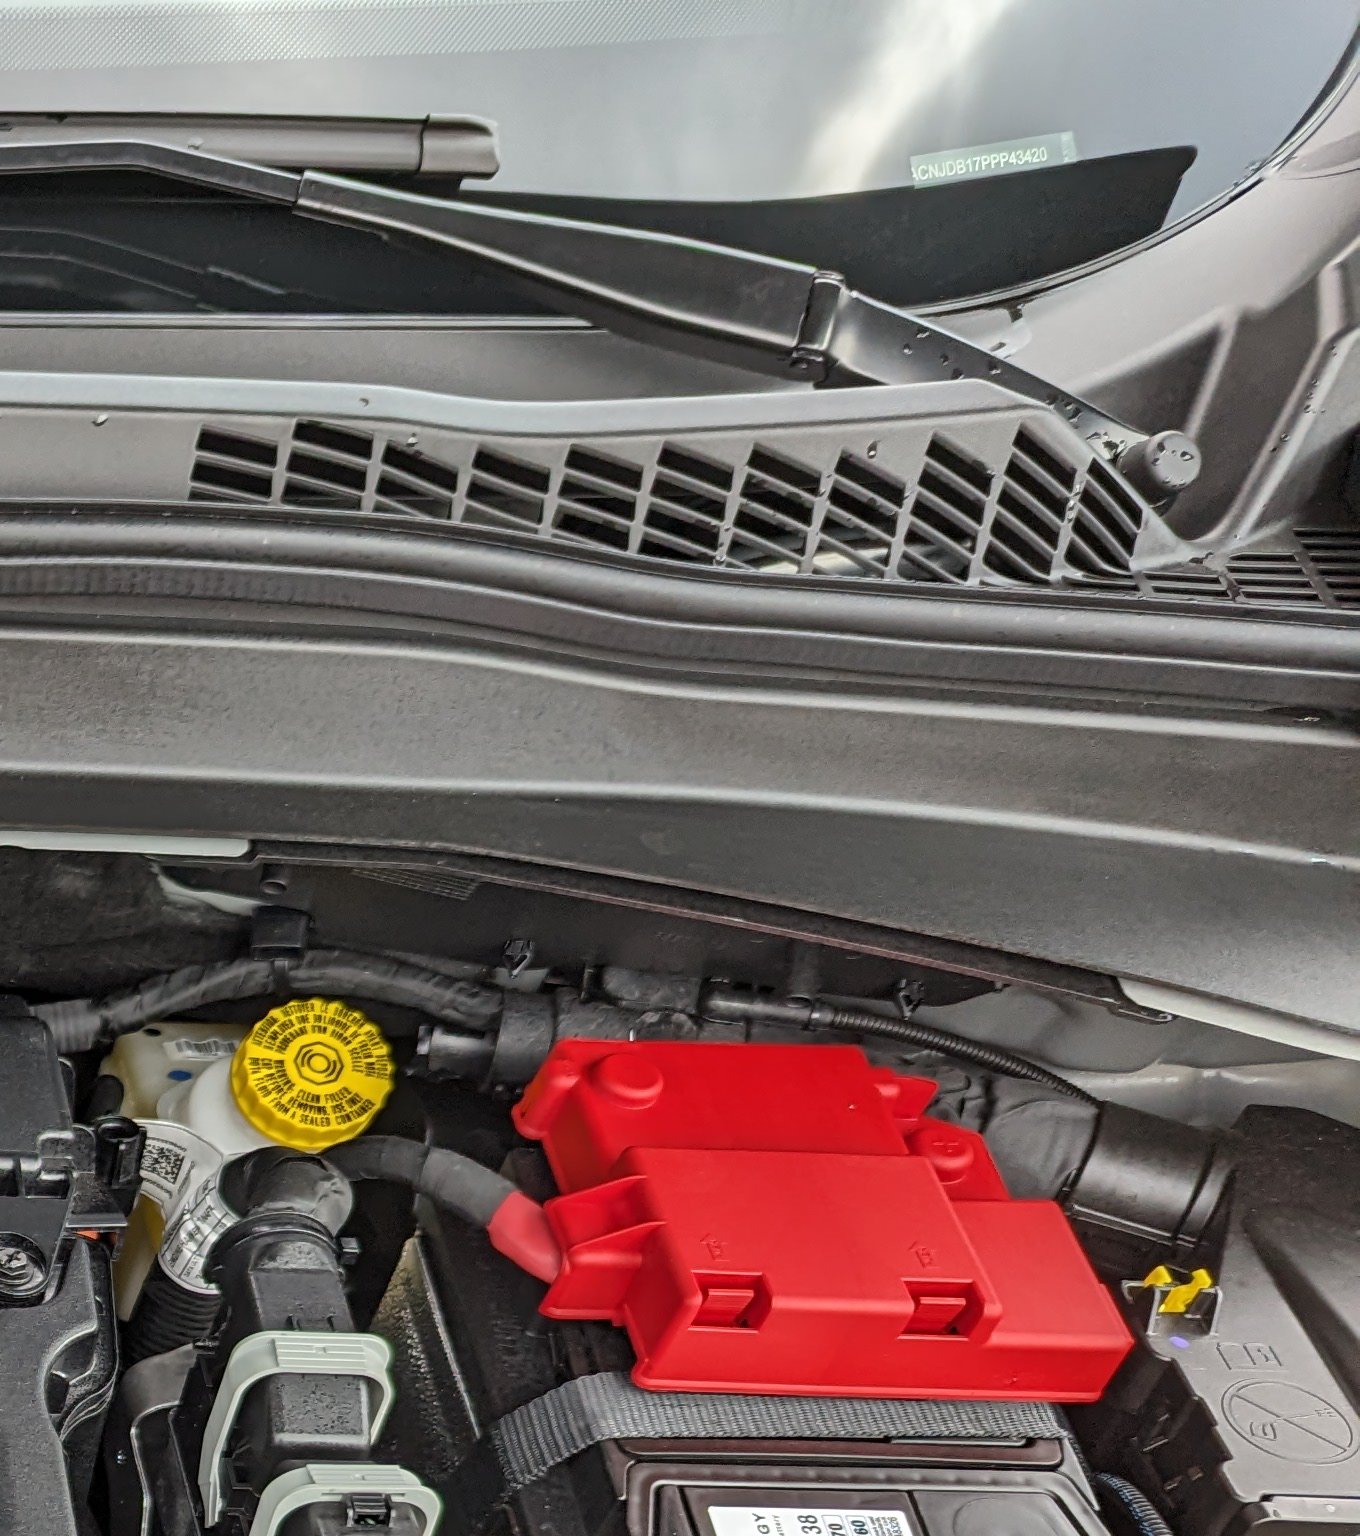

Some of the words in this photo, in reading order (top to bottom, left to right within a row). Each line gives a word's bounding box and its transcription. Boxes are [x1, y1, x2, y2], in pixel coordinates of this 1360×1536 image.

[296, 1089, 321, 1103] CLEAN
[269, 1098, 289, 1115] FROM
[299, 1117, 331, 1127] SEALED
[335, 1099, 376, 1125] CONTAINER
